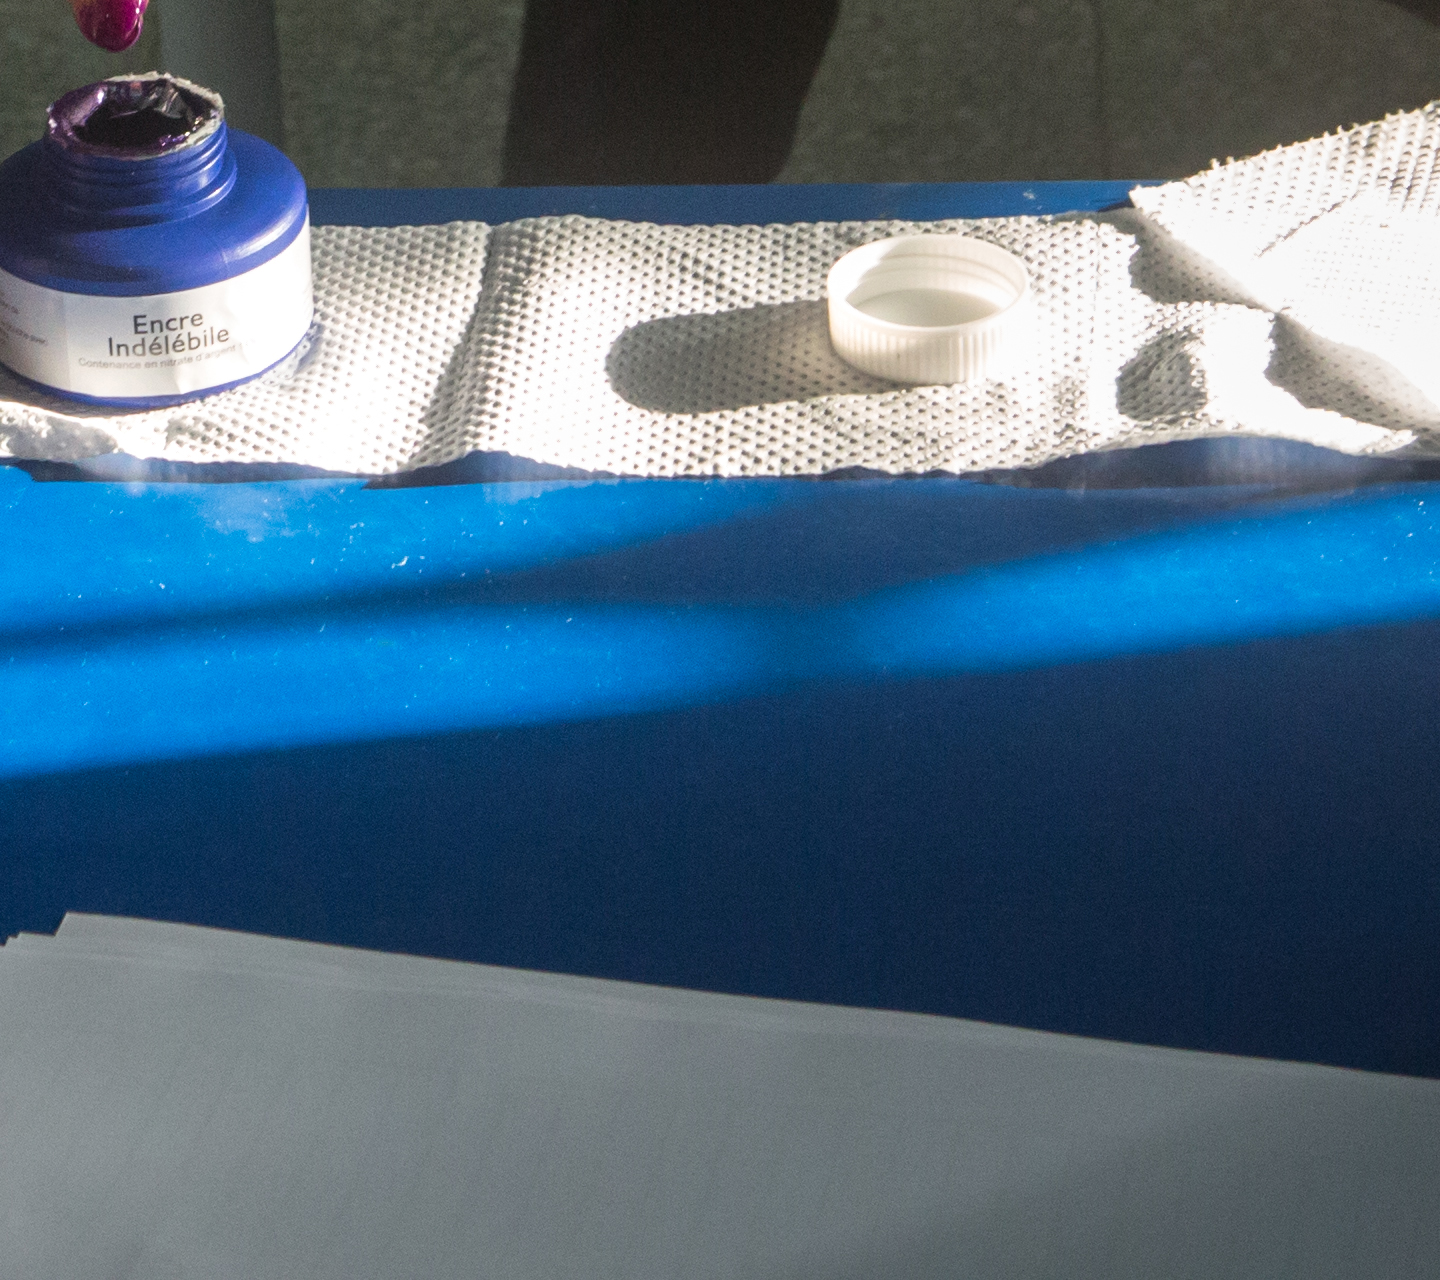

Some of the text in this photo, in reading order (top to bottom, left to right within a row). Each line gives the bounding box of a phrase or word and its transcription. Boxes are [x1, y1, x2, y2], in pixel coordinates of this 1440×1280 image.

[132, 312, 204, 335] Encre
[107, 326, 230, 358] Indélébile
[78, 356, 142, 369] Contenance
[144, 360, 159, 369] en
